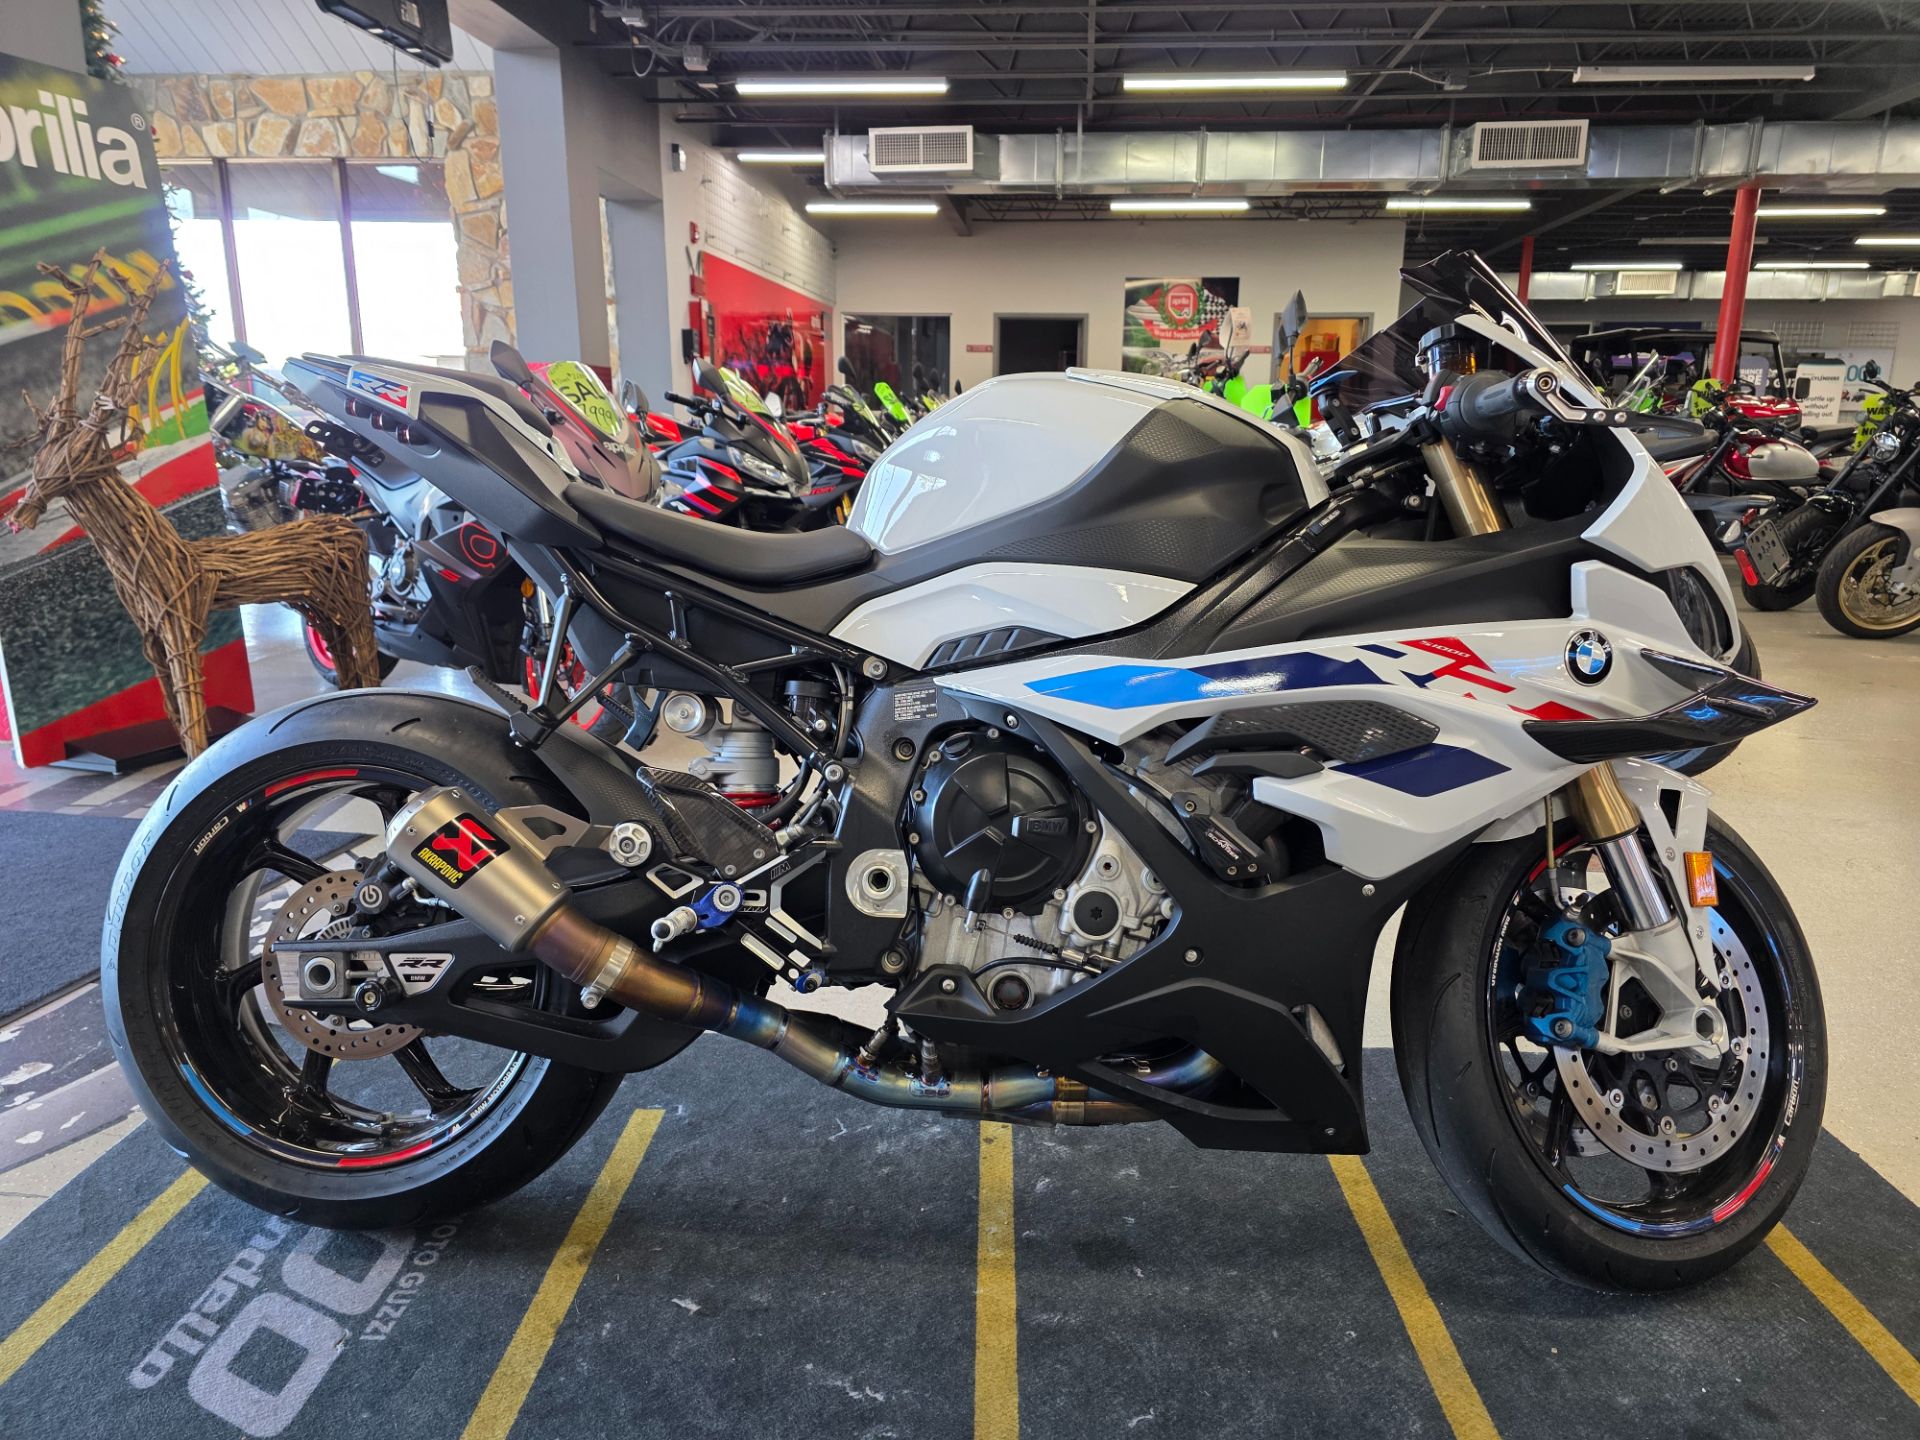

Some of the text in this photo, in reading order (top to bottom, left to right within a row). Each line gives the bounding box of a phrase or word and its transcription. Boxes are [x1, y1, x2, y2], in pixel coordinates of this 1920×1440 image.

[559, 379, 606, 404] SAL
[1419, 640, 1471, 659] S1000
[1573, 631, 1612, 654] BMW
[193, 816, 229, 856] Carbon
[1032, 820, 1066, 833] BMW
[397, 959, 447, 969] RR
[469, 1101, 488, 1120] BMW
[1784, 1079, 1800, 1127] Carbon
[359, 1270, 426, 1341] GUZZI
